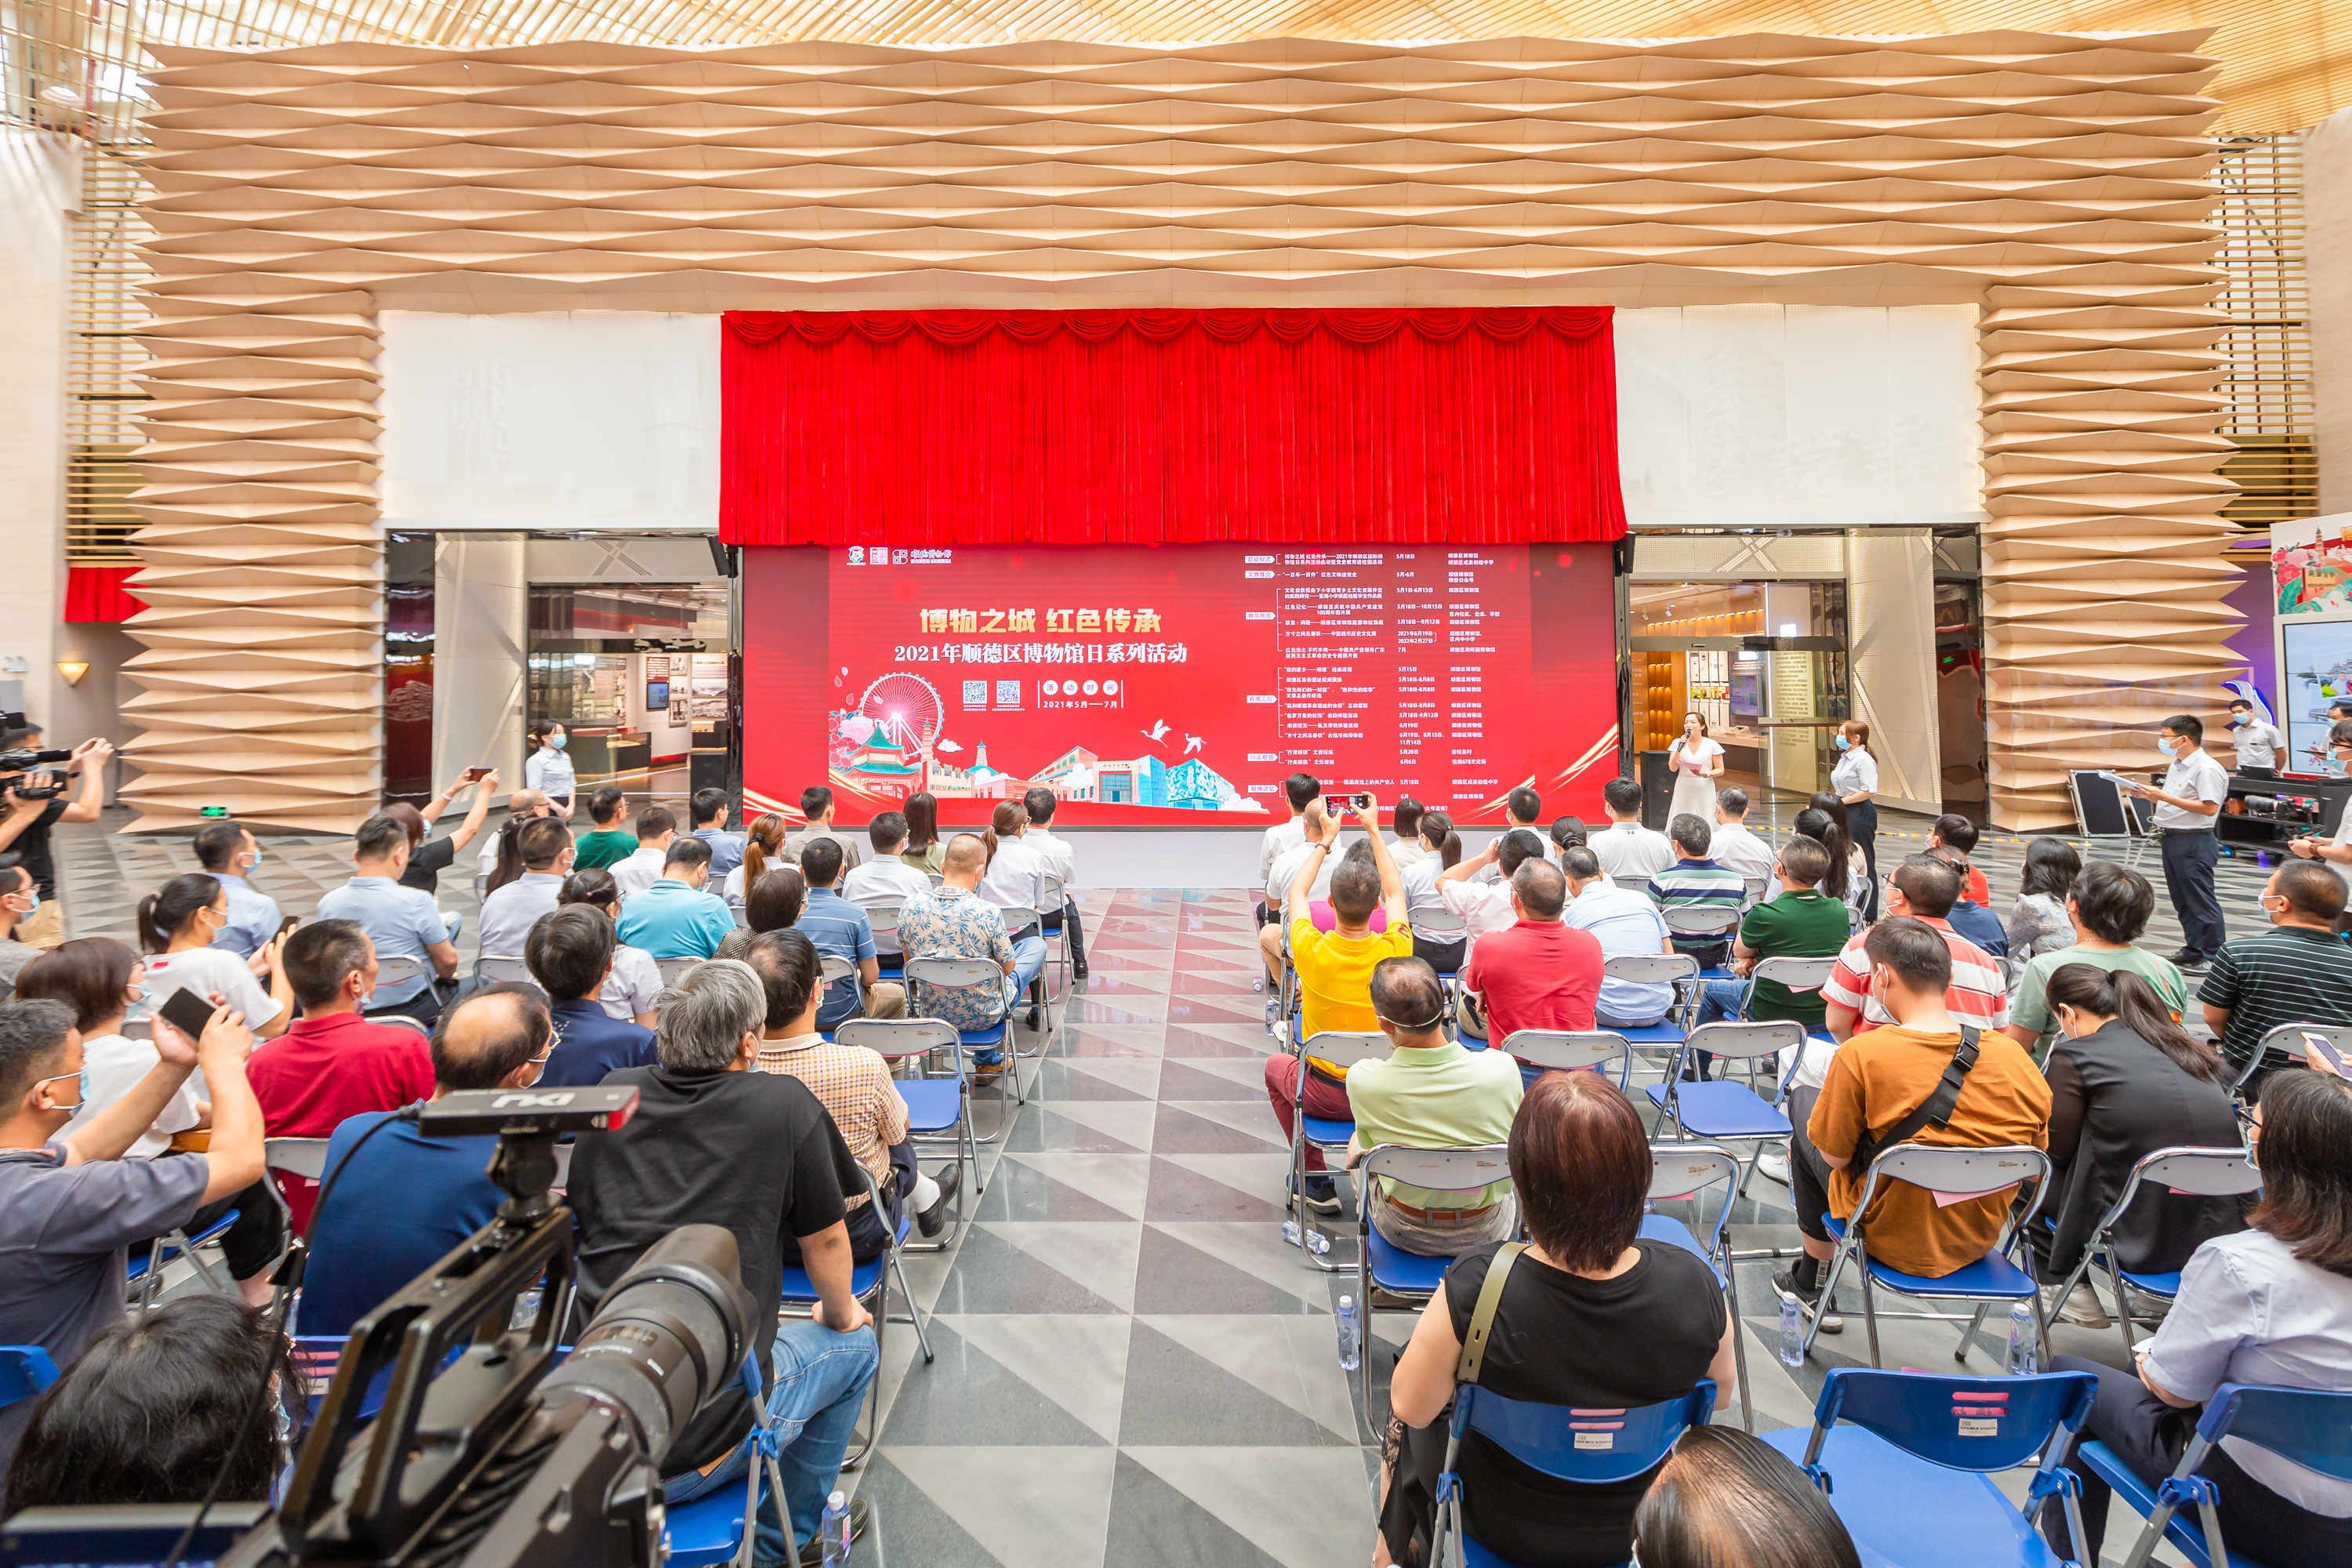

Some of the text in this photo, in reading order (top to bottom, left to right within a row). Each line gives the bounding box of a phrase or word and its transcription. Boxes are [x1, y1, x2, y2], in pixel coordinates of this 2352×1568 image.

[920, 608, 1161, 633] 博物之城 红色传承
[895, 642, 1187, 663] 2021年顺德区博物馆日系列活动
